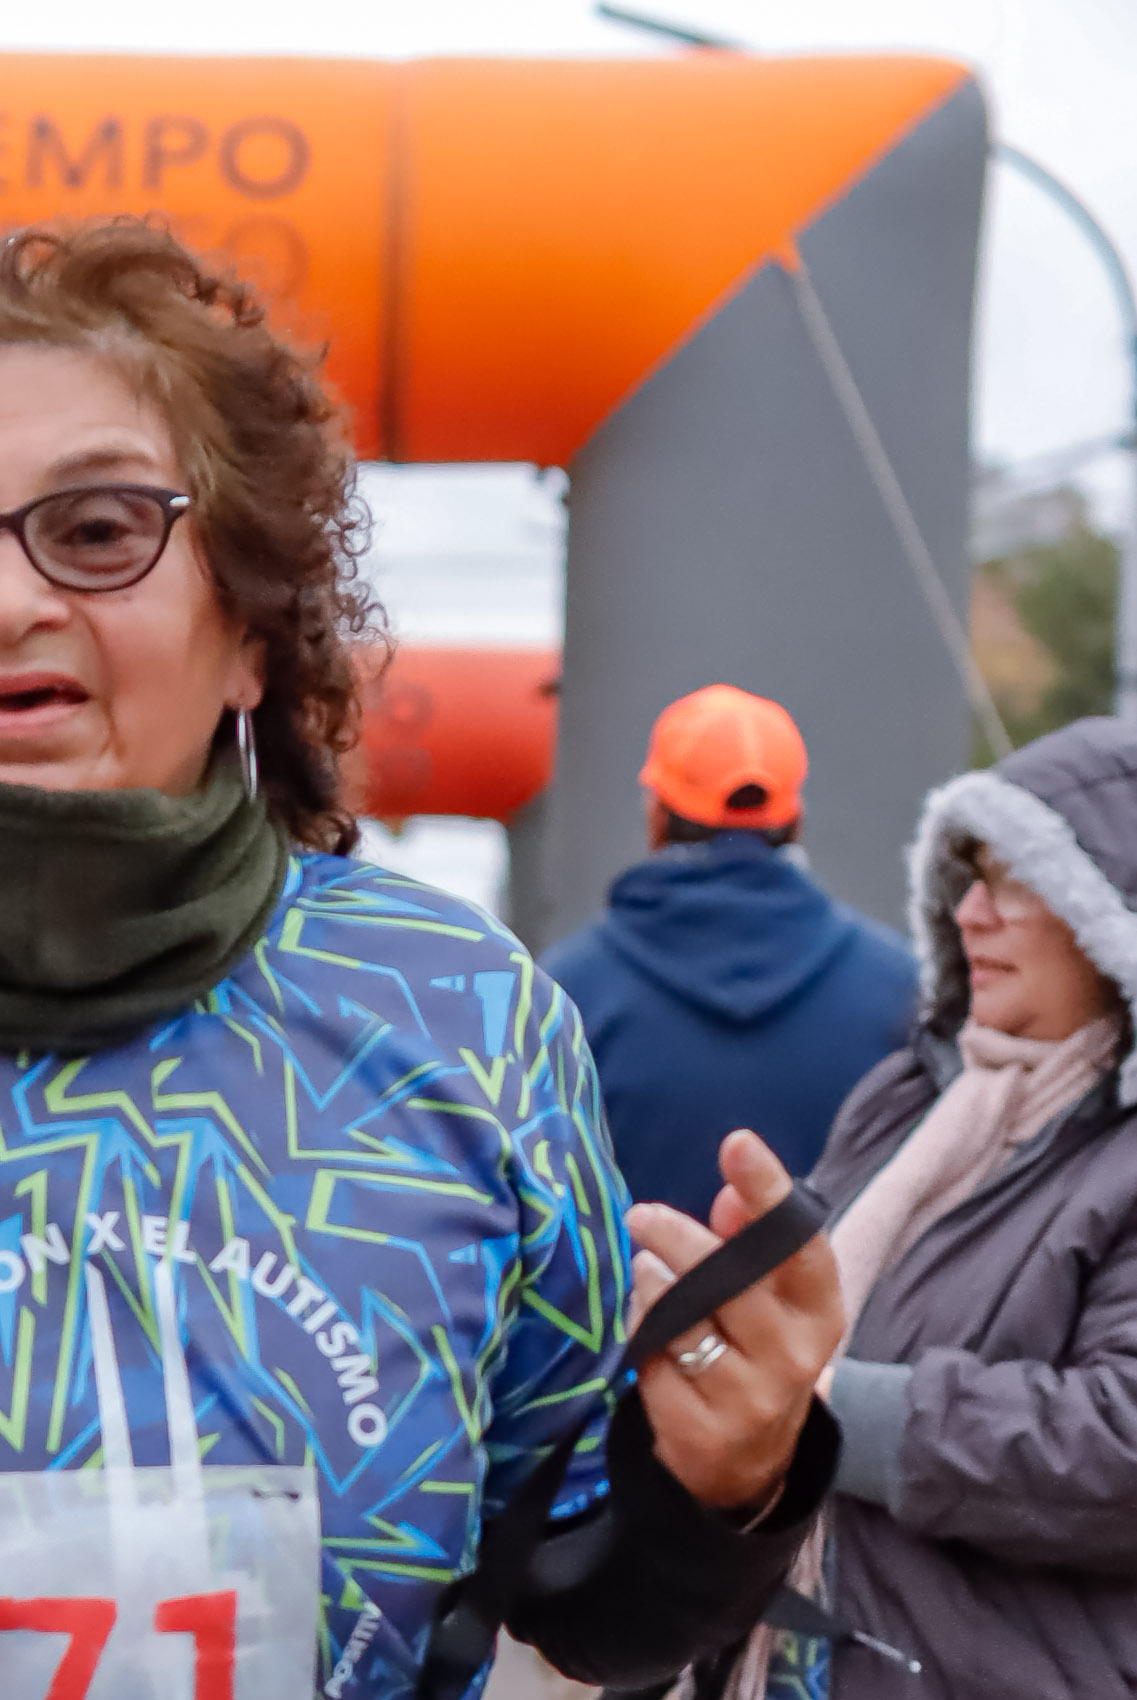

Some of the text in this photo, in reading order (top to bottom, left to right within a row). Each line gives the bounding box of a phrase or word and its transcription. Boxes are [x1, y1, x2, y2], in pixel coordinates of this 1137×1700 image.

[85, 1210, 126, 1254] X
[140, 1214, 197, 1265] EL
[208, 1234, 389, 1449] AUTISMO
